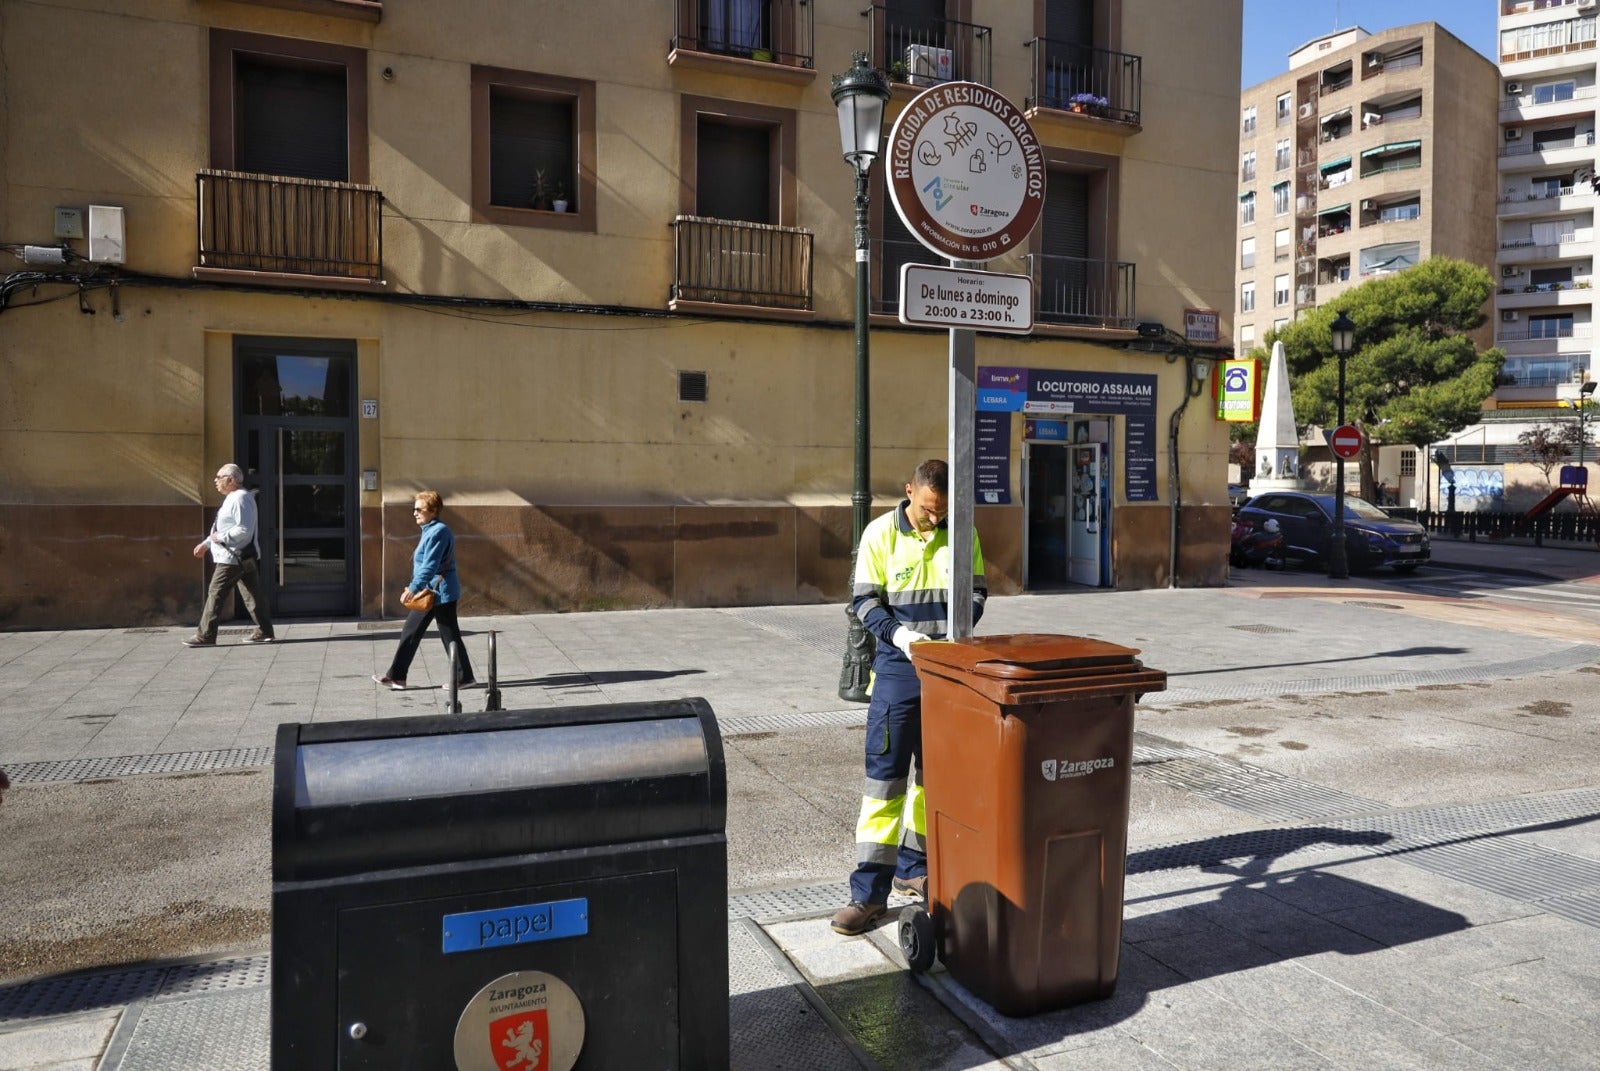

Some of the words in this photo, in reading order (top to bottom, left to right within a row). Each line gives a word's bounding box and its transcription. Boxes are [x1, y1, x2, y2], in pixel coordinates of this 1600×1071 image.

[895, 107, 928, 179] RECOGIDA
[924, 92, 944, 113] DE
[943, 87, 1011, 119] RESIDUOS
[1008, 114, 1042, 199] ORGÁNICOS
[980, 206, 1010, 217] Zaragoza
[920, 220, 960, 250] INFORMACIÓN
[962, 244, 971, 252] EN
[982, 241, 997, 251] 010
[957, 276, 985, 286] Horario:
[921, 283, 935, 299] De
[937, 285, 965, 302] lunes
[966, 291, 973, 303] a
[974, 288, 1019, 310] domingo
[925, 305, 958, 318] 20:00
[960, 310, 967, 319] a
[970, 308, 1002, 321] 23:00
[1004, 310, 1015, 323] h.
[1036, 380, 1100, 394] LOCUTORIO
[1101, 383, 1152, 396] ASSALAM
[983, 396, 1008, 404] LEBARA
[1219, 400, 1251, 410] LOCUTORIO
[363, 404, 376, 415] 127
[1059, 757, 1115, 774] Zaragoza
[479, 905, 554, 948] papel
[489, 983, 547, 1001] Zaragoza
[488, 997, 547, 1014] AYUNTAMIENTO
